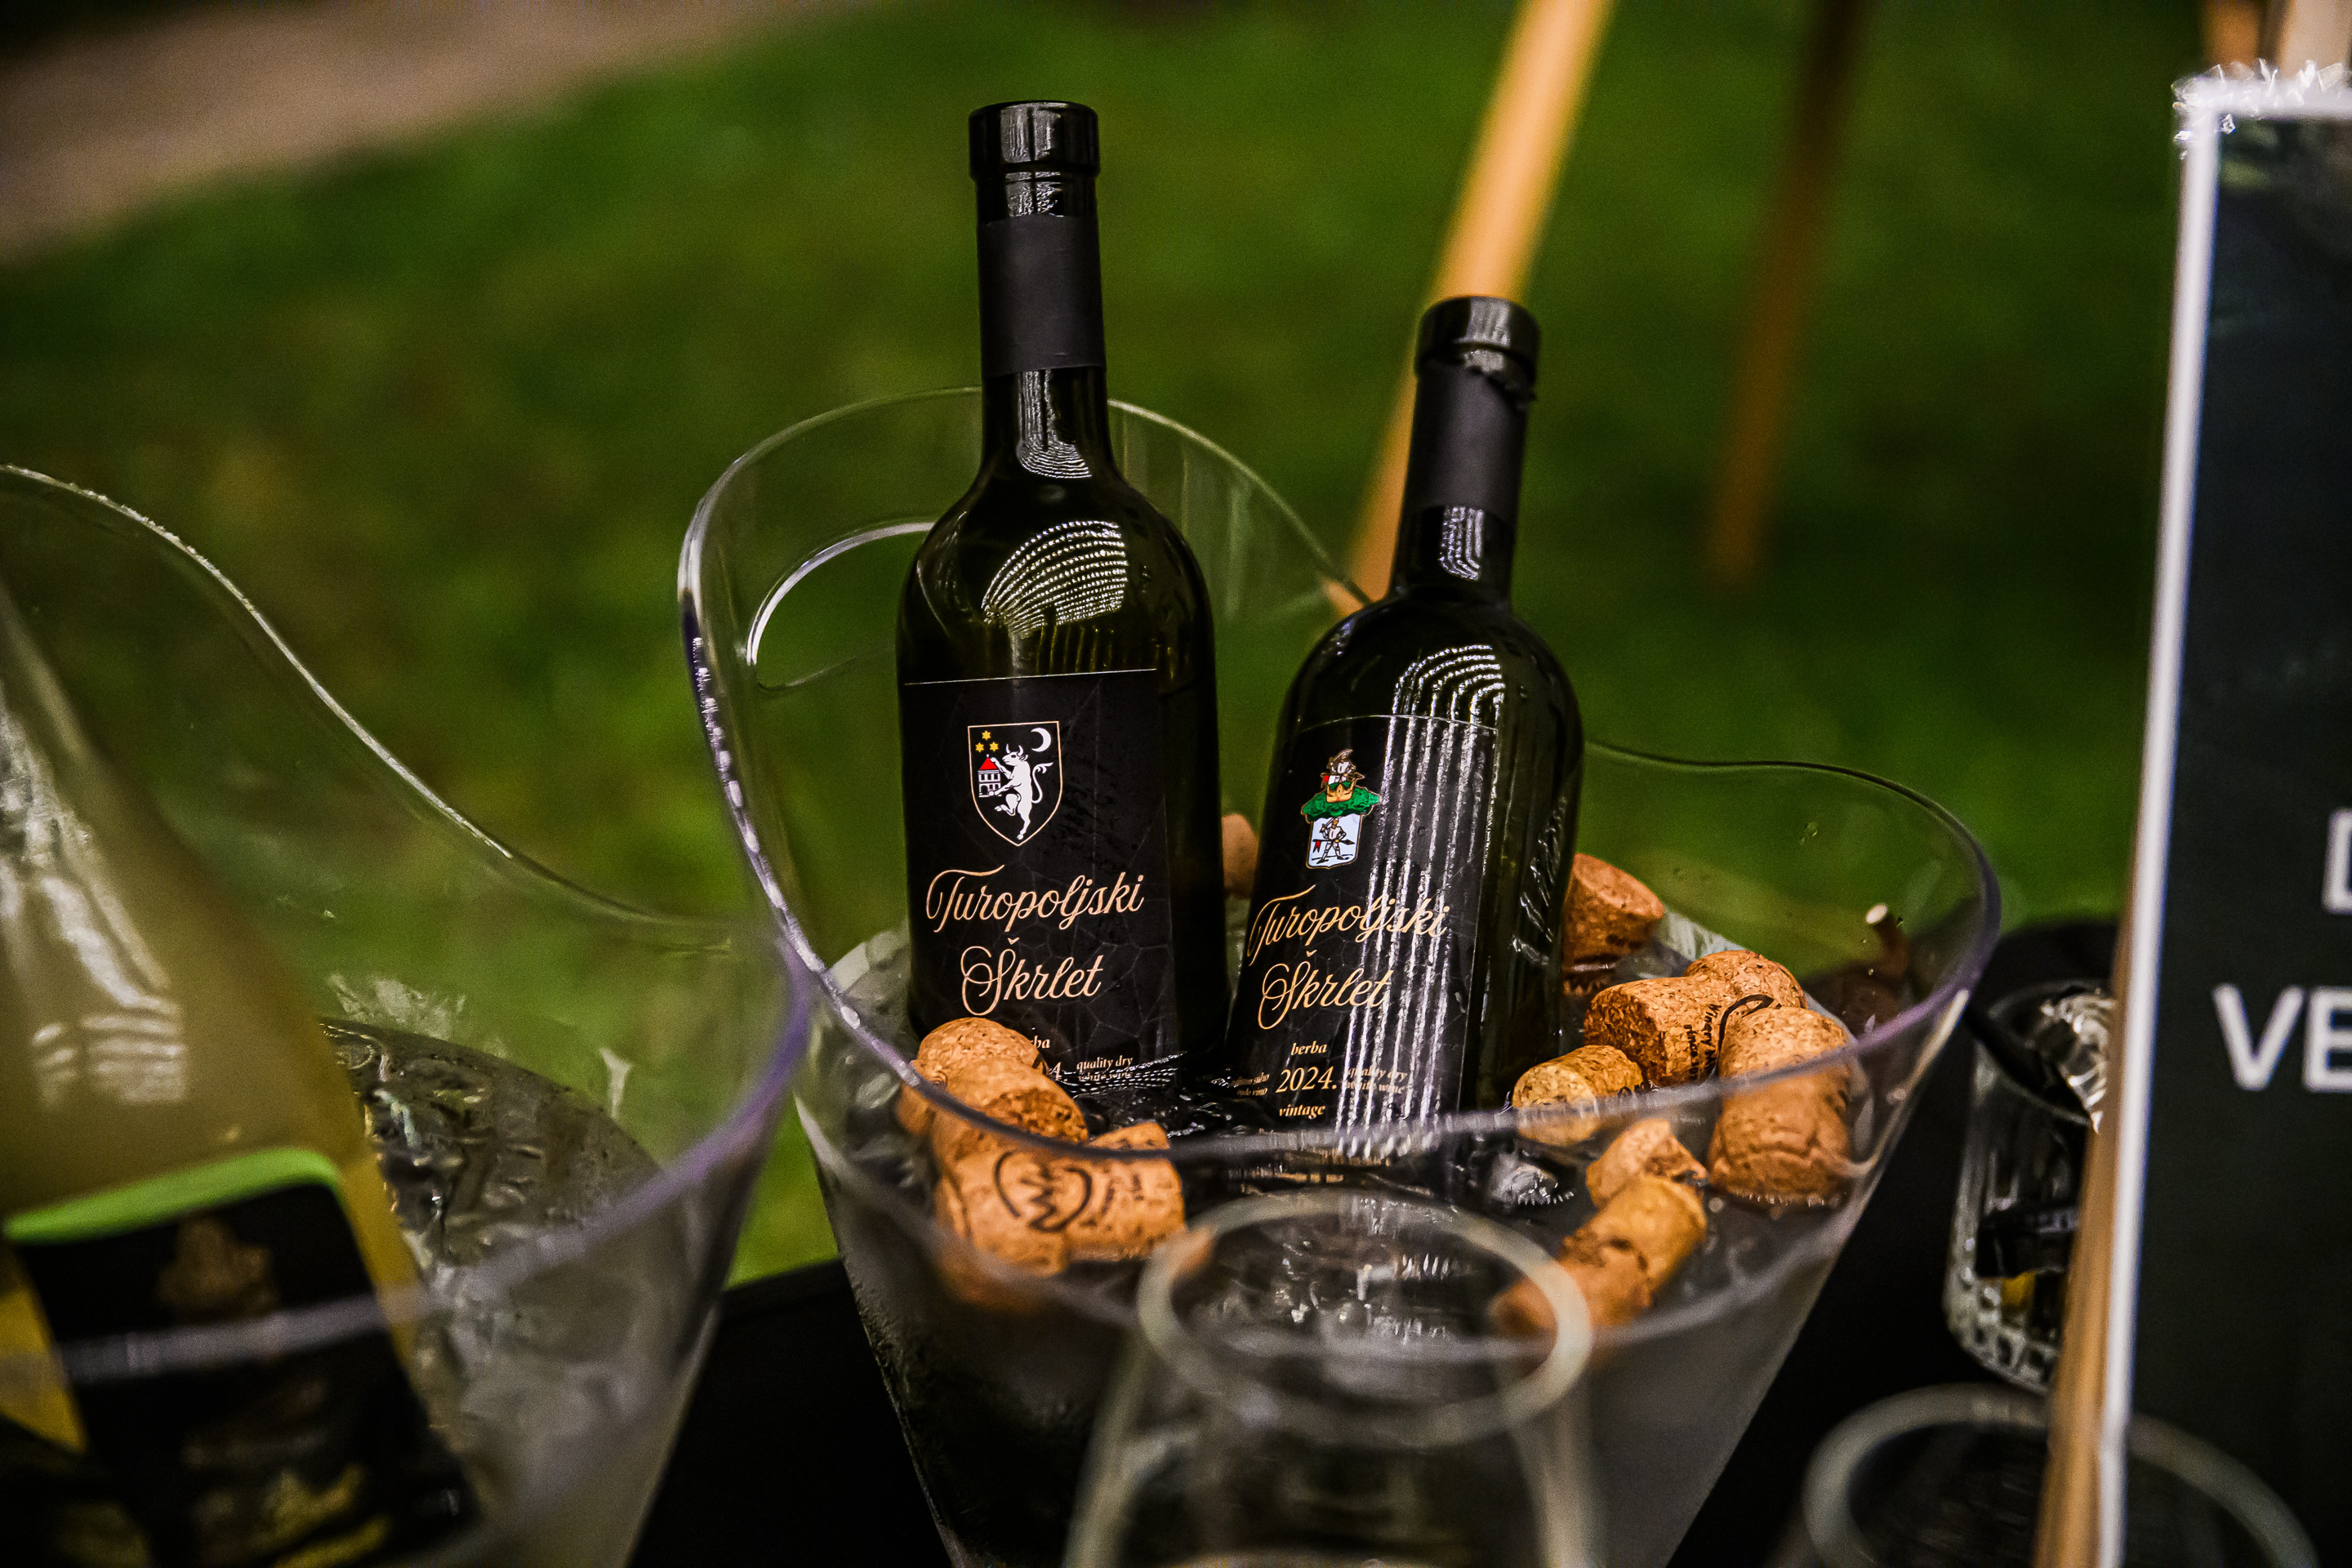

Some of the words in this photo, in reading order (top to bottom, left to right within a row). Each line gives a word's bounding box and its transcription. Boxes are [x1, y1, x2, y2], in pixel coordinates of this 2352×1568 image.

[925, 864, 1145, 933] Turopoljski
[1248, 884, 1450, 967] Turopoljski
[960, 938, 1104, 1015] Škrlet
[1258, 949, 1392, 1031] Škrlet
[1076, 1057, 1113, 1075] quality
[1116, 1054, 1134, 1071] dry
[1290, 1040, 1327, 1056] berba
[1276, 1066, 1338, 1094] 2024.
[1279, 1103, 1326, 1120] vintage
